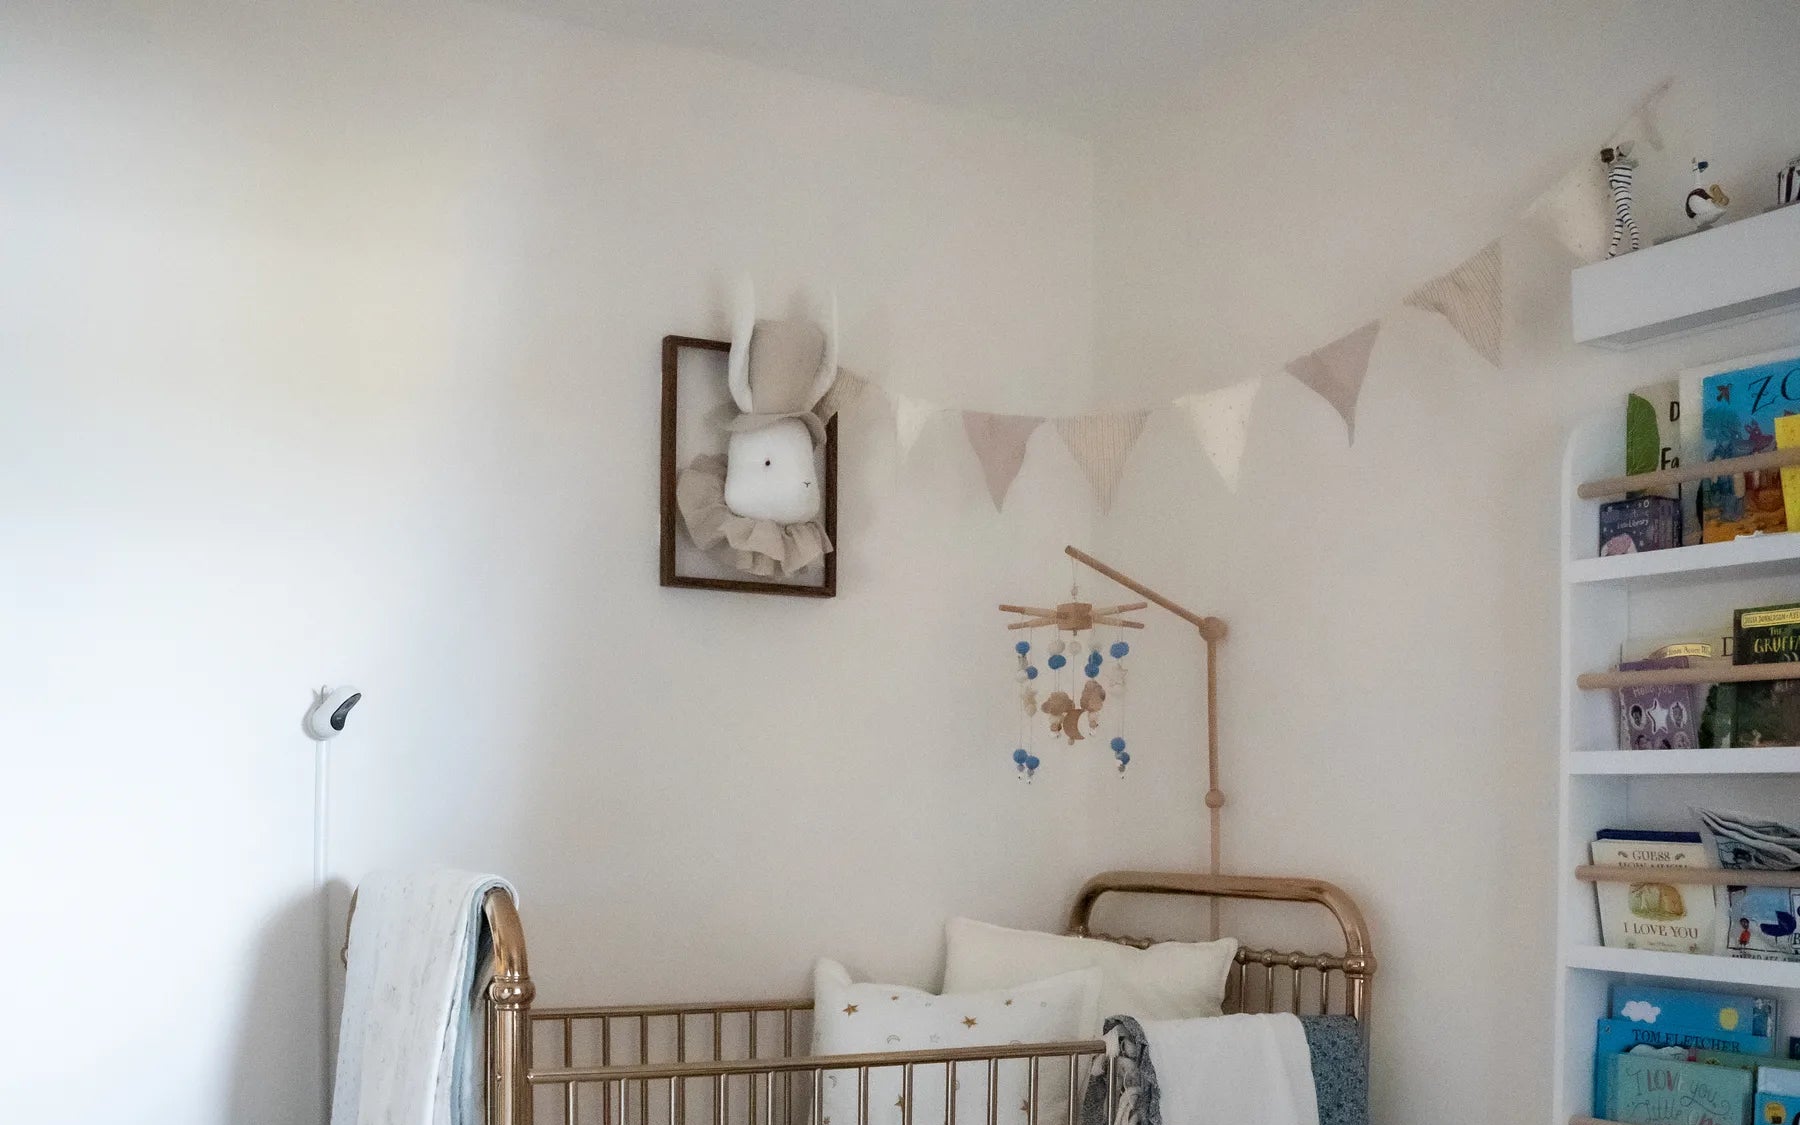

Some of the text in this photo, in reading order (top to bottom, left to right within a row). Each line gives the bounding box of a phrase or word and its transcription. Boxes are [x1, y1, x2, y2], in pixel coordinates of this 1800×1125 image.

[1661, 447, 1680, 470] Fa
[1632, 850, 1671, 861] GUESS
[1623, 922, 1699, 939] I LOVE YOU
[1632, 1029, 1741, 1053] TOM FLETCHER
